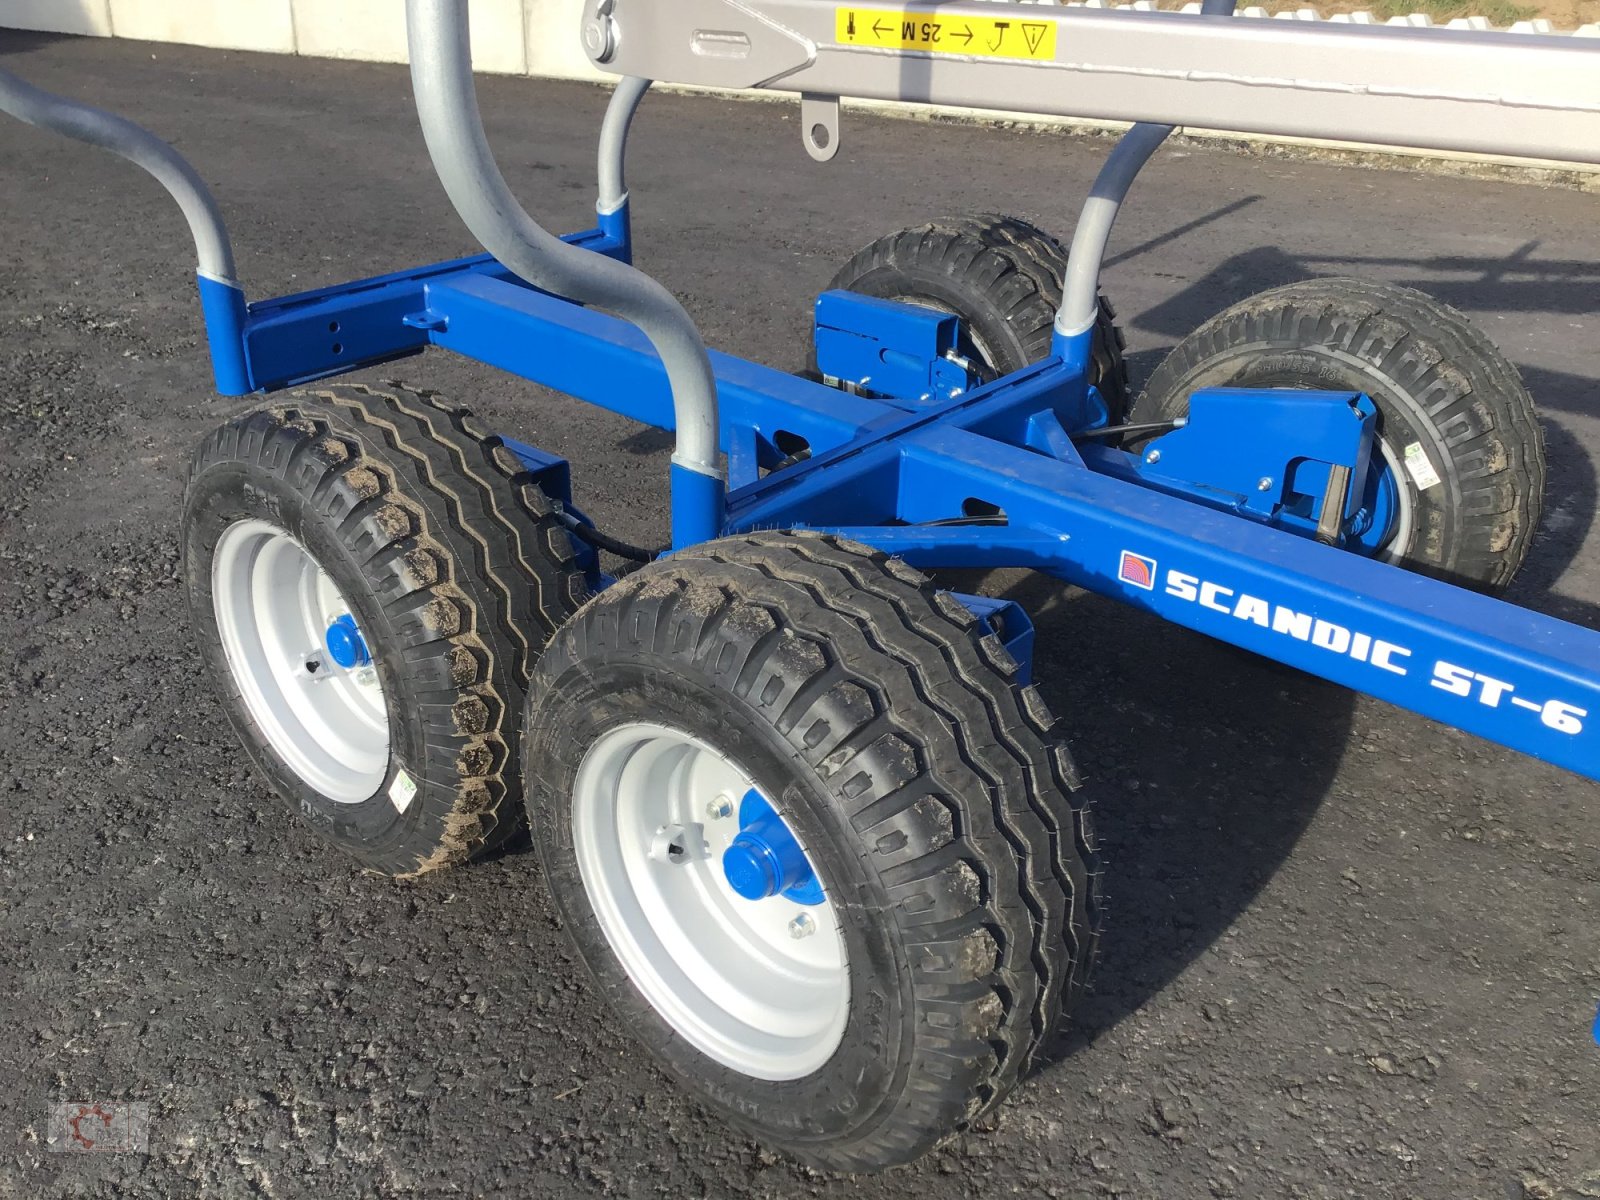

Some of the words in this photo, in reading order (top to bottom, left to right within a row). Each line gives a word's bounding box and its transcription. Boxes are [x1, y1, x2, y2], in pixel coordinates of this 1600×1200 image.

[901, 21, 916, 40] M
[921, 22, 942, 42] 25
[1165, 569, 1412, 676] SCANDIC
[1430, 660, 1588, 735] ST-6
